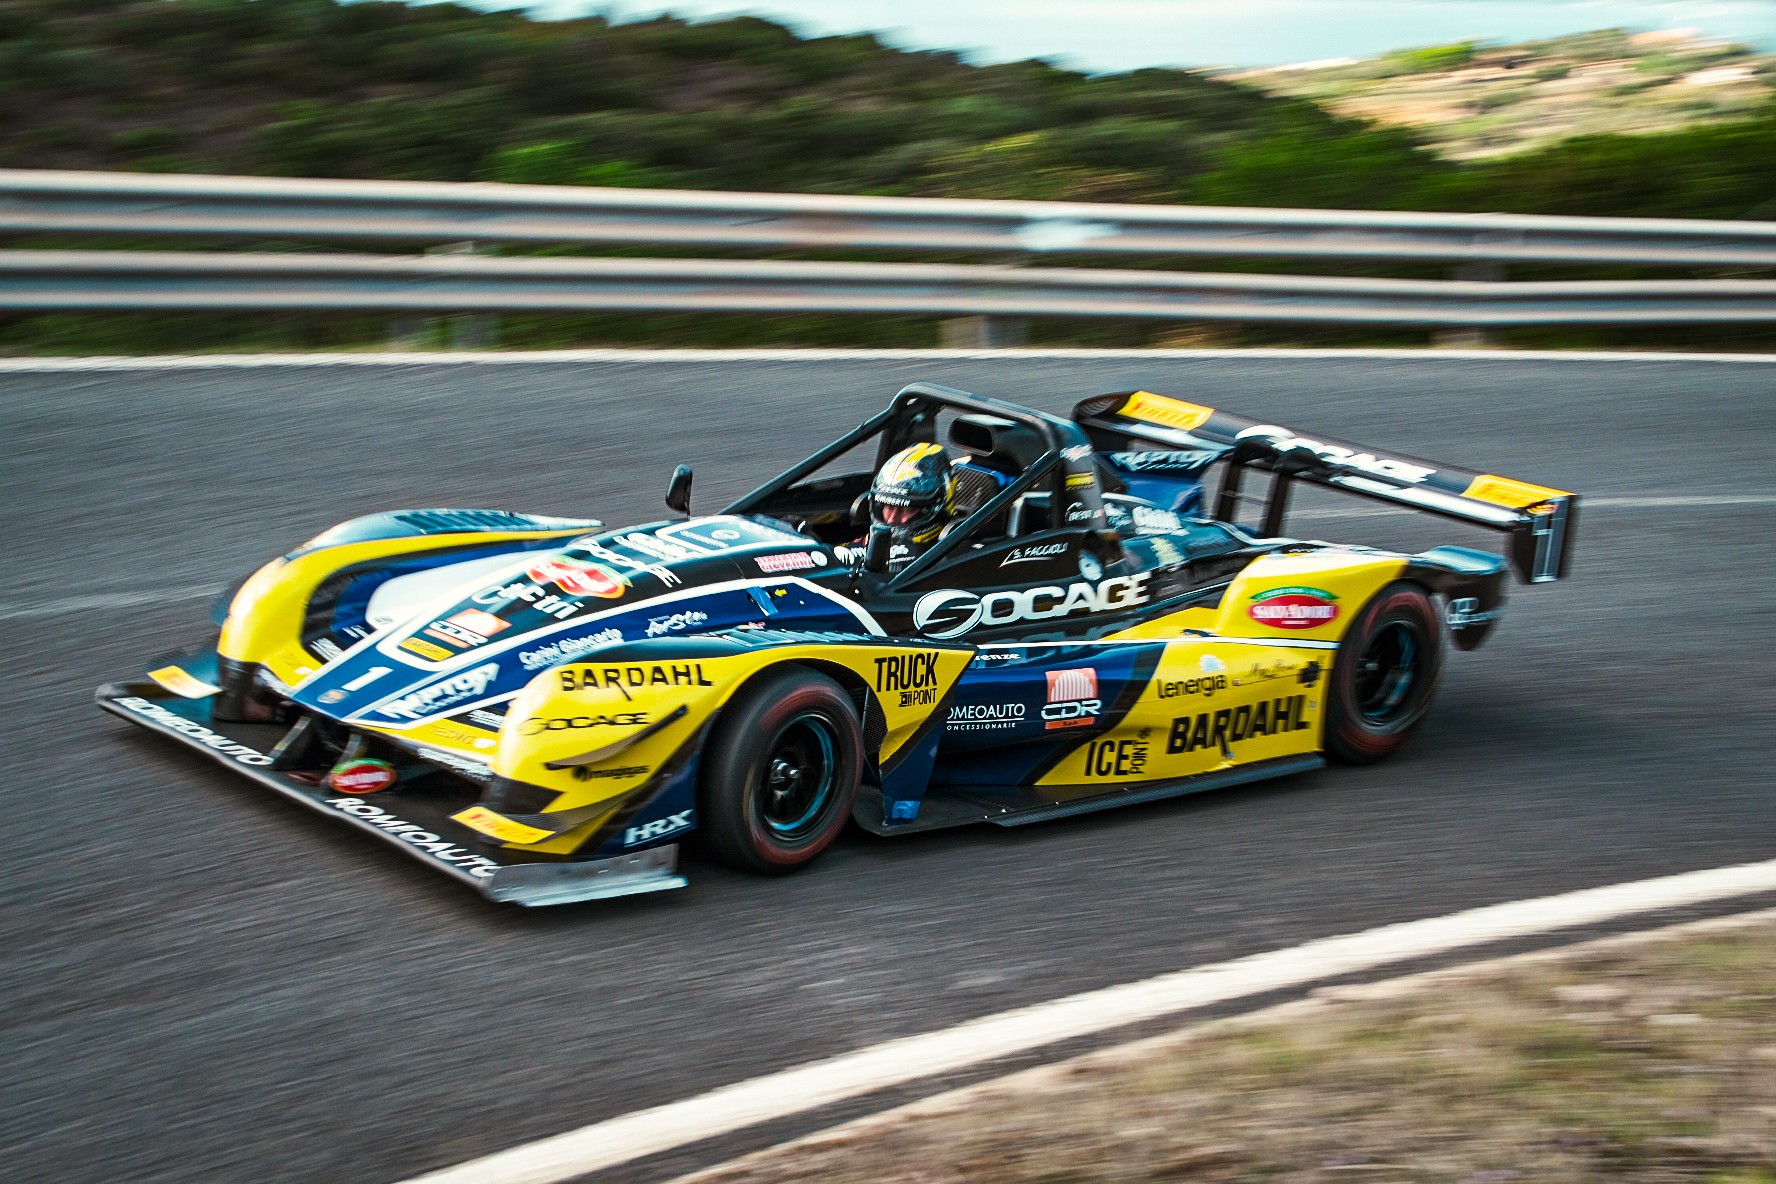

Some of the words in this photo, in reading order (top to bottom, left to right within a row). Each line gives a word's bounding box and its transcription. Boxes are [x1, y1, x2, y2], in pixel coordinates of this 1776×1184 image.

[912, 572, 1152, 639] GOCAGE
[341, 666, 394, 692] 1
[561, 664, 713, 701] BARDAHL
[874, 652, 939, 692] TRUCK
[912, 688, 937, 706] POINT
[1041, 699, 1102, 719] CDR
[517, 711, 649, 736] GOCAGE
[1166, 694, 1311, 758] BARDAHL
[1084, 740, 1136, 777] ICE
[1128, 741, 1150, 774] POINT
[623, 808, 694, 846] HRX
